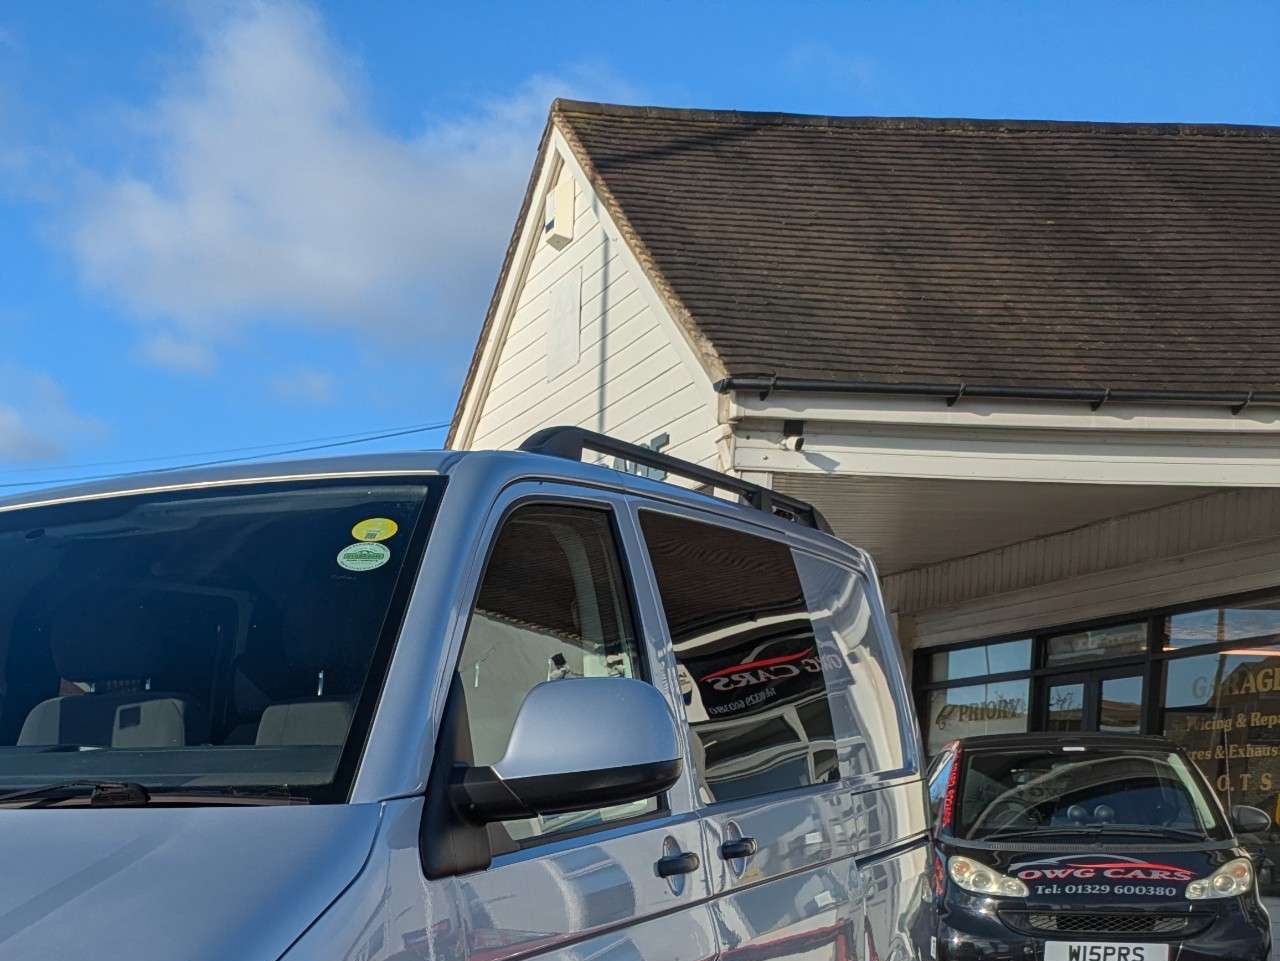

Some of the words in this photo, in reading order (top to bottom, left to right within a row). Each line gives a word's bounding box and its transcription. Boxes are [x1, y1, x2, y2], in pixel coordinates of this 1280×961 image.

[1214, 745, 1226, 759] &
[1019, 868, 1095, 880] OWG
[1103, 868, 1193, 881] CARS
[1034, 885, 1061, 895] Tel:
[1064, 884, 1110, 894] 01329
[1114, 885, 1176, 896] 600380
